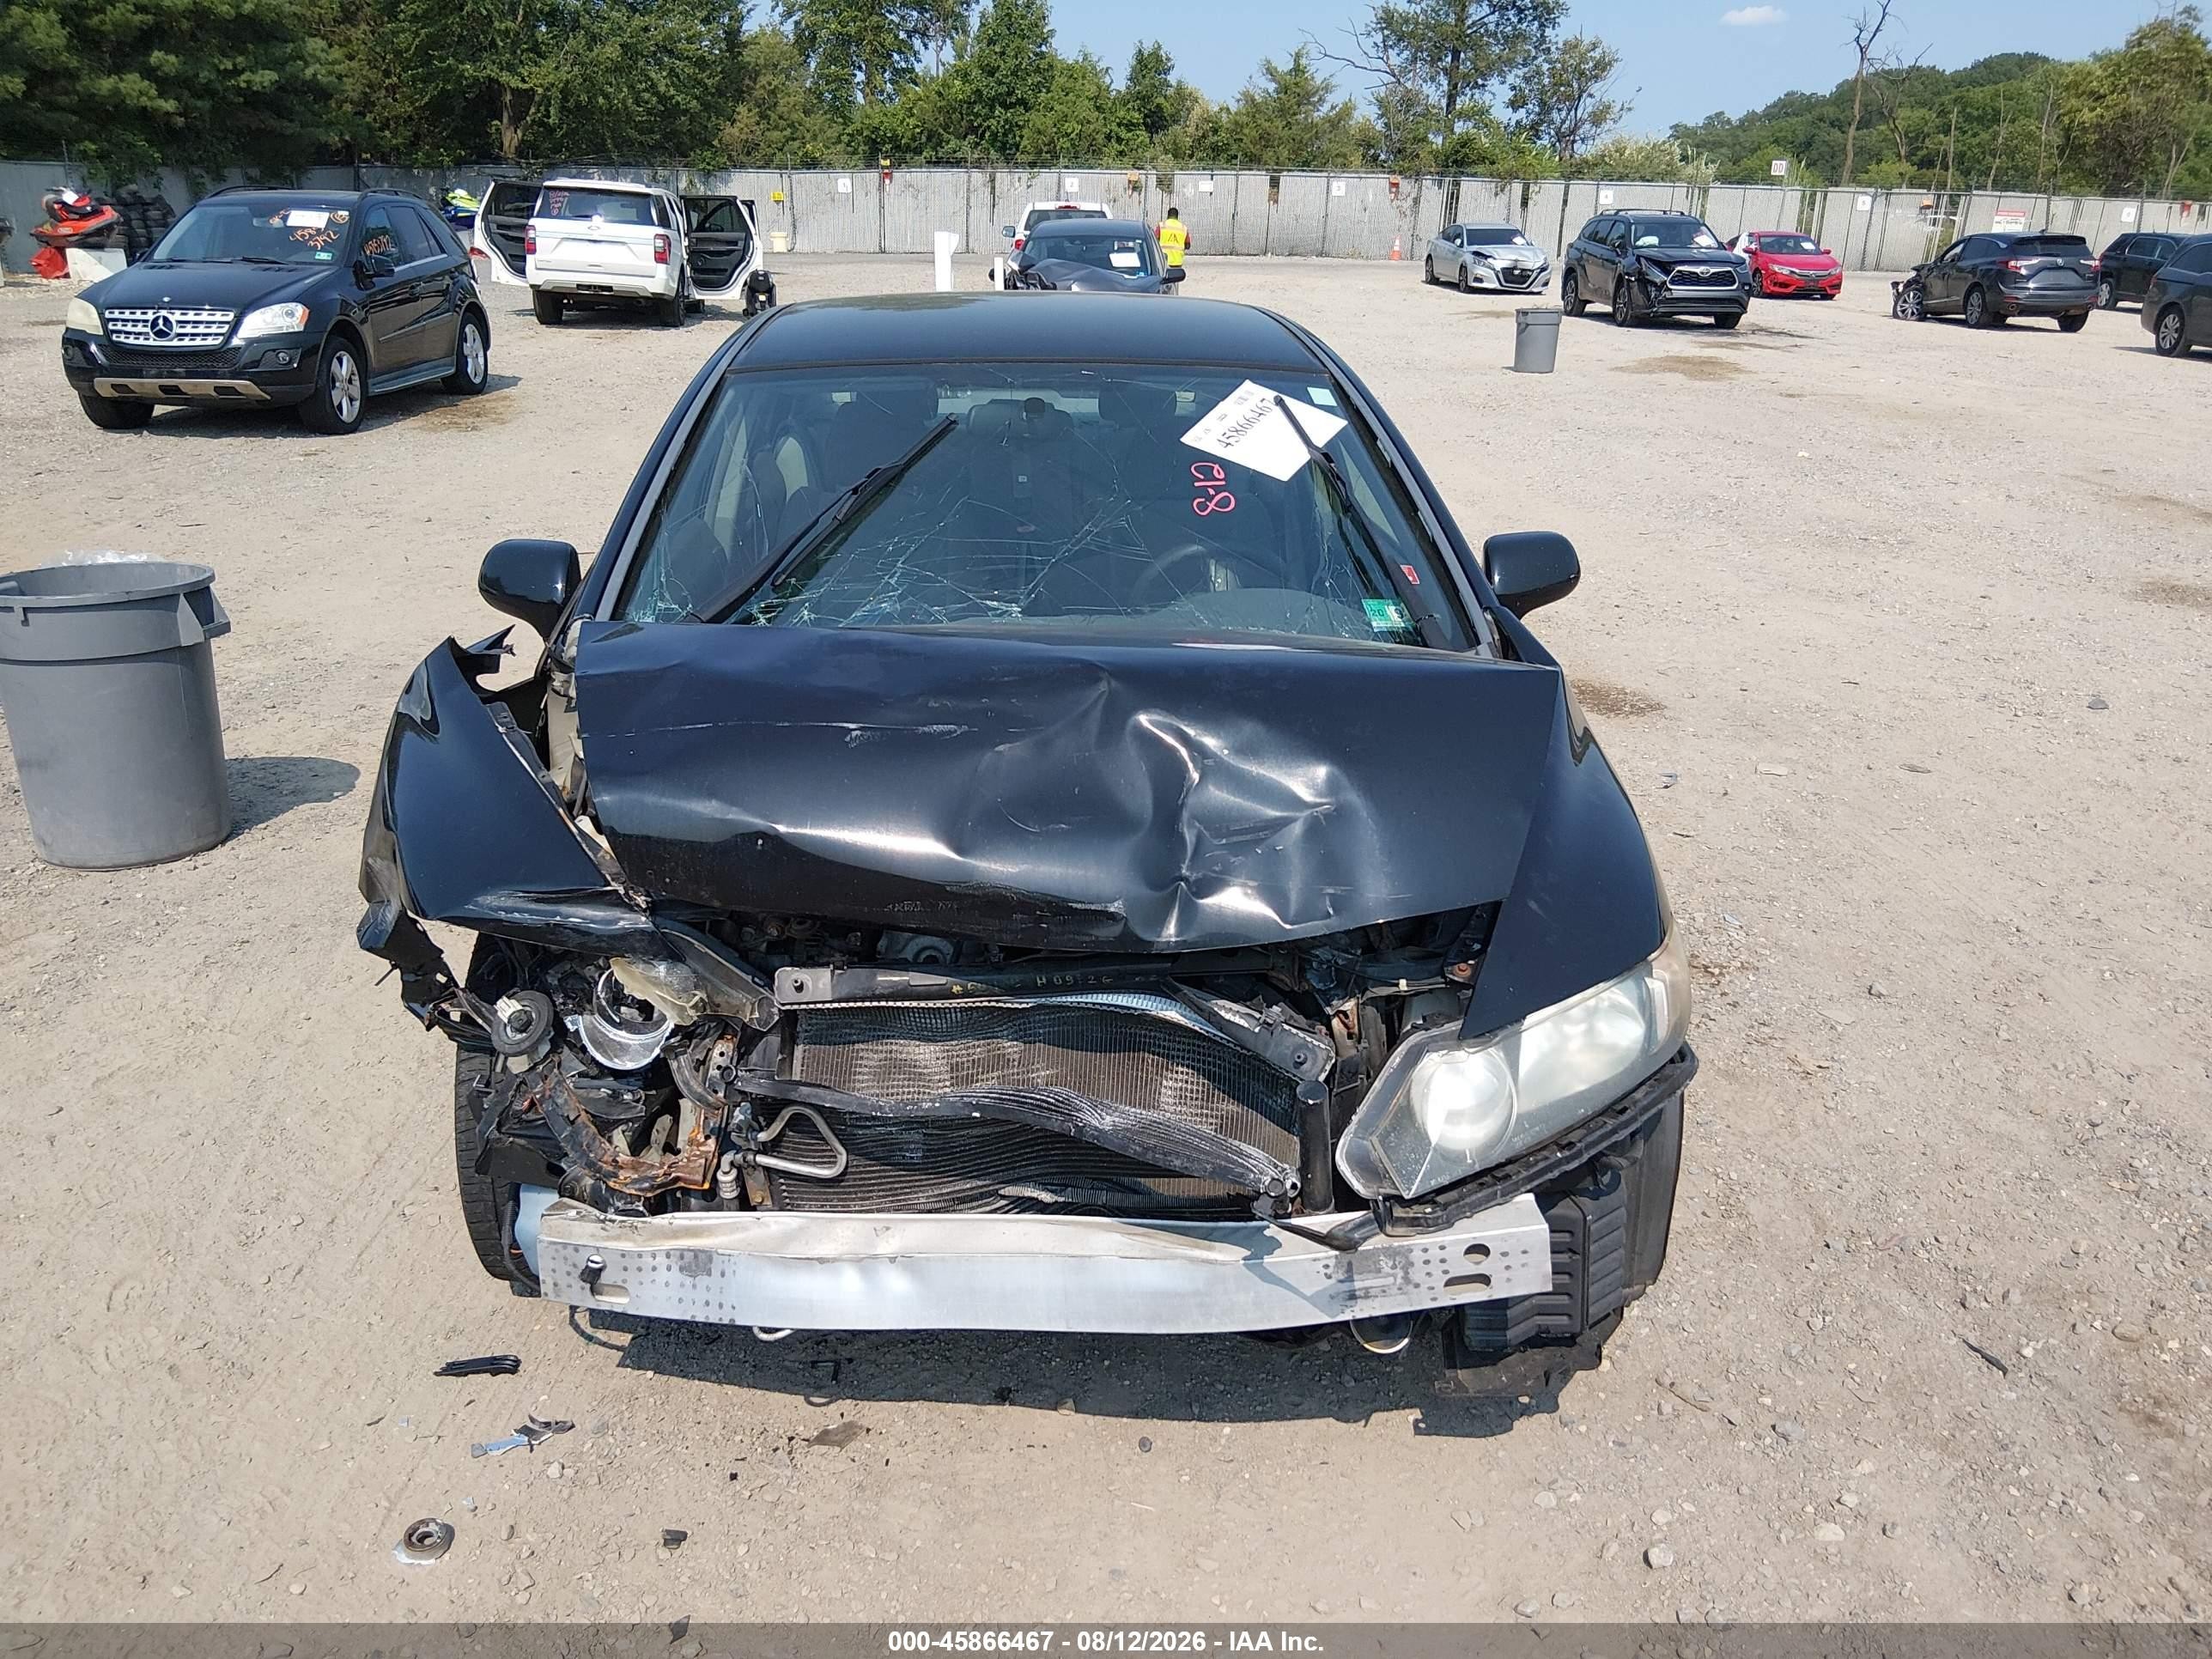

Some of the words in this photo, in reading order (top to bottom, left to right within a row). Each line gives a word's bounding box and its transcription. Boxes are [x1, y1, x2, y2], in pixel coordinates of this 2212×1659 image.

[1773, 163, 1784, 173] DD
[307, 230, 340, 250] 3792
[1216, 398, 1276, 448] 45866467
